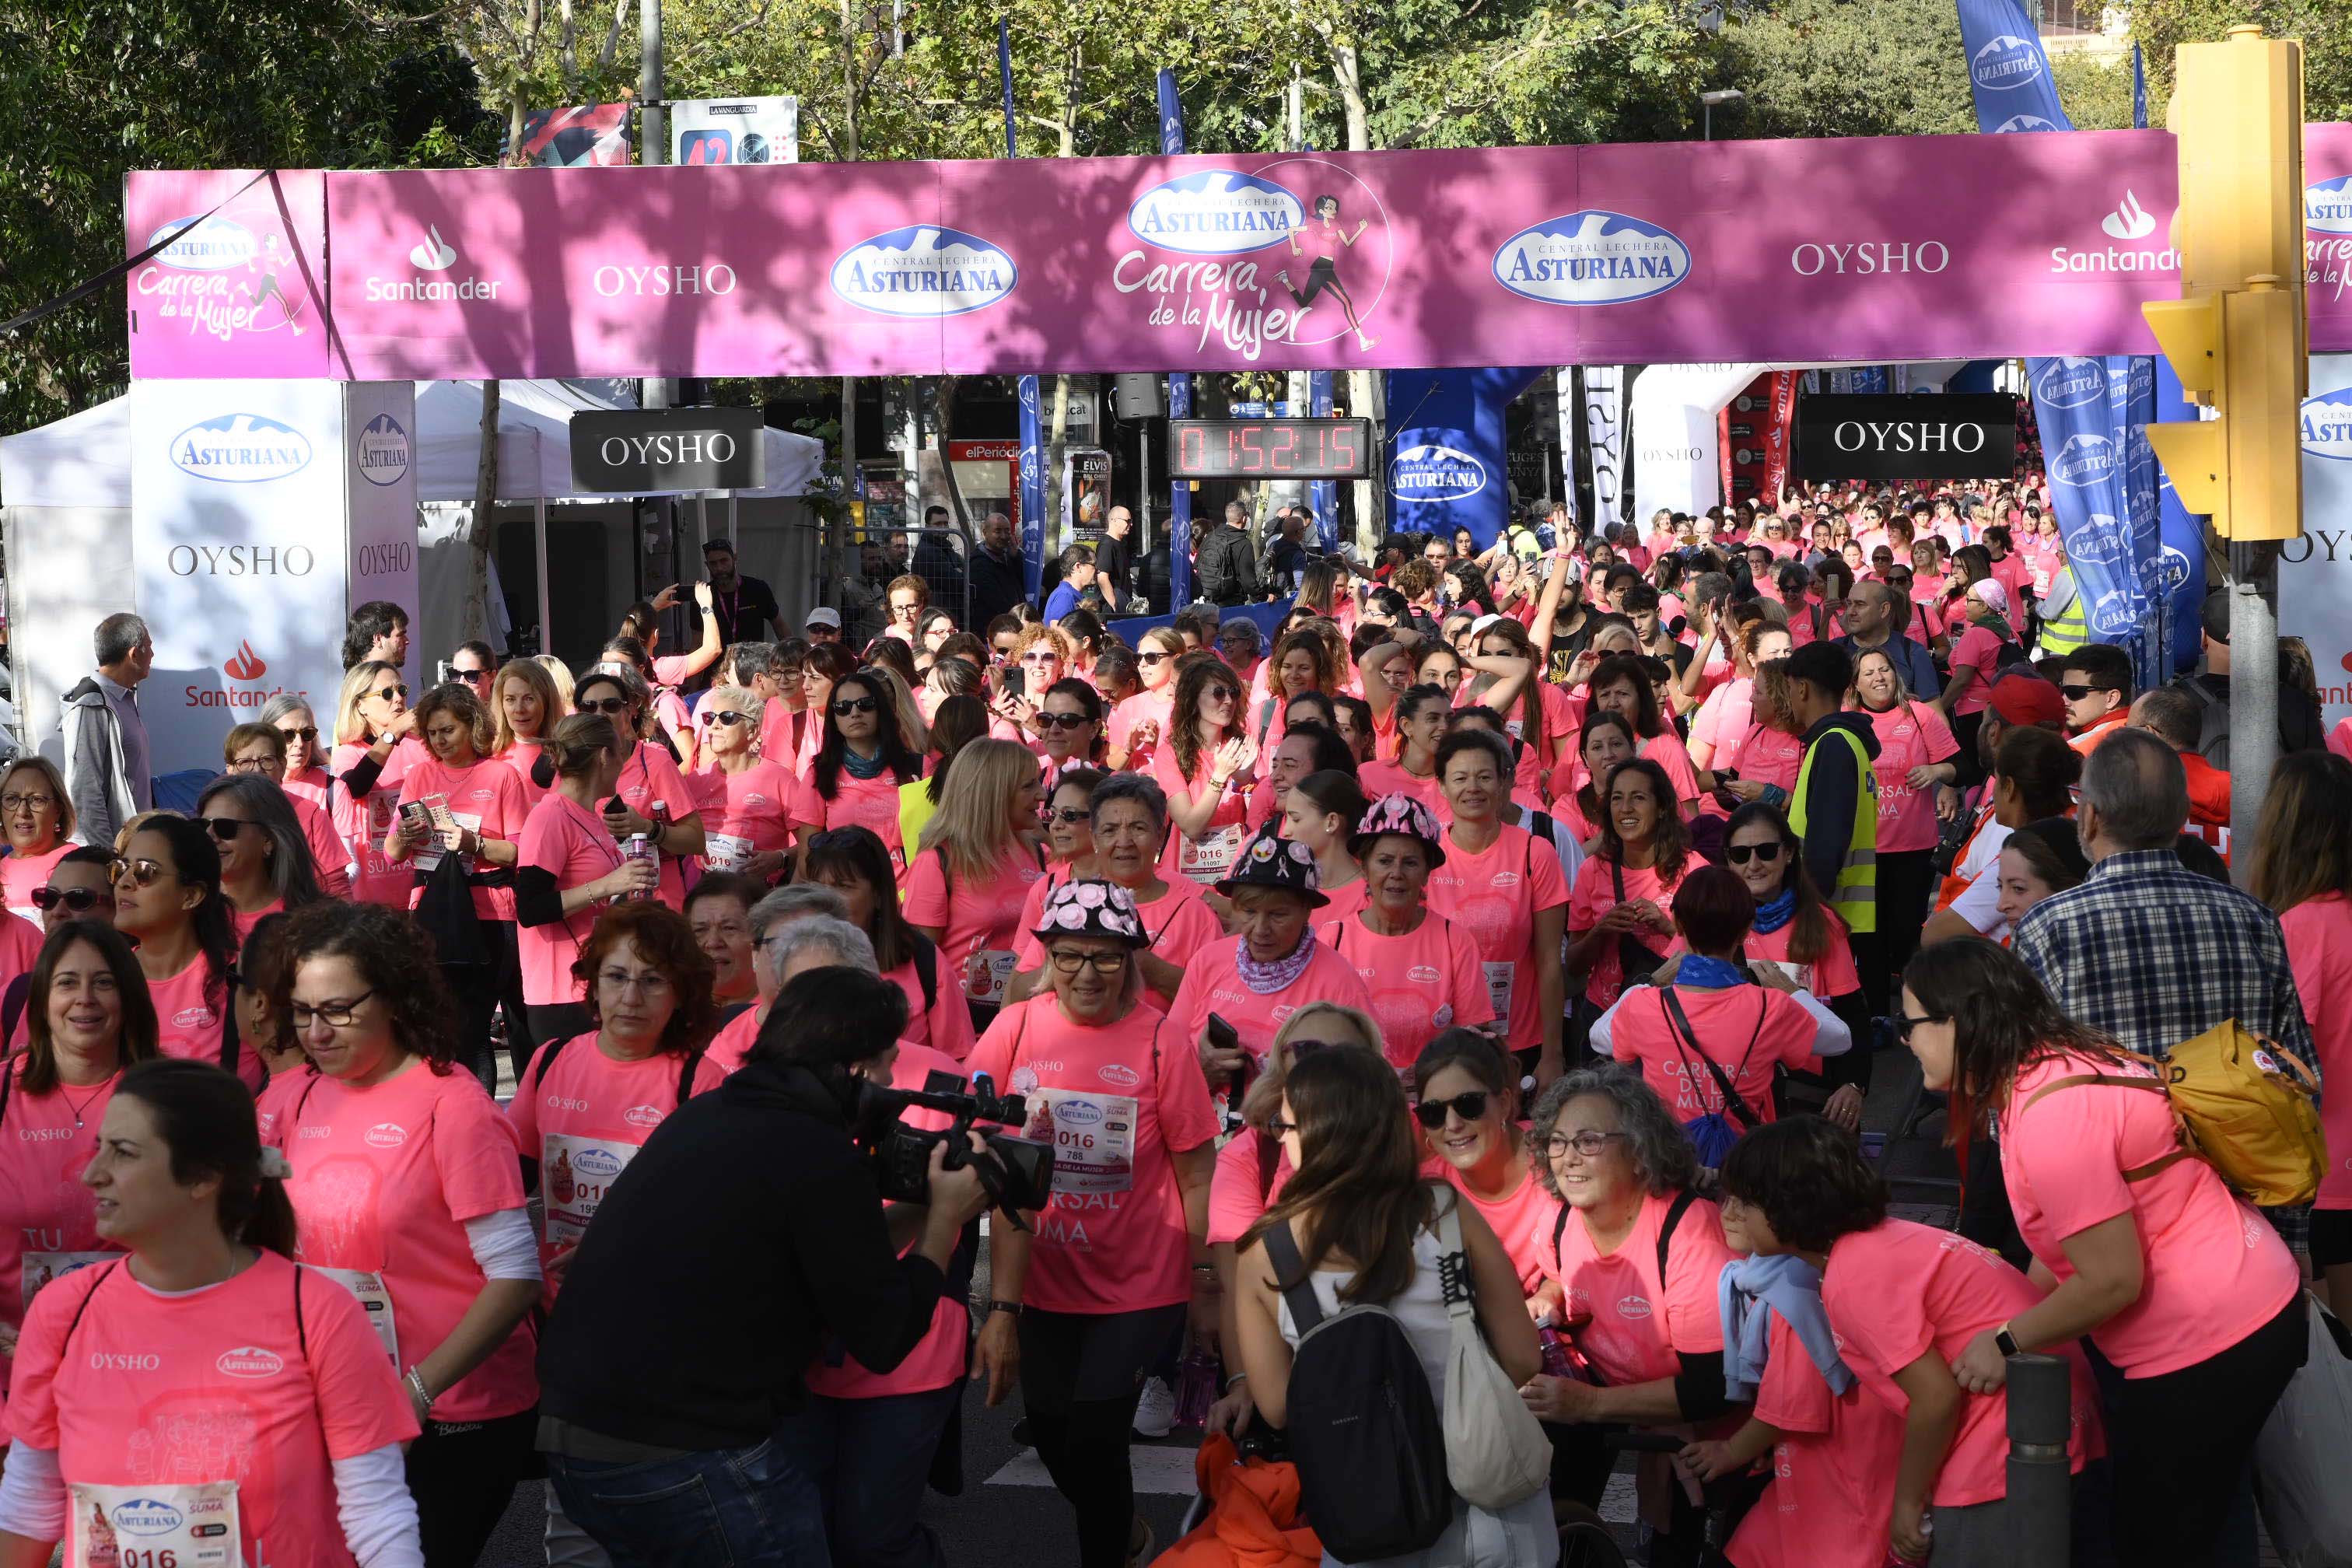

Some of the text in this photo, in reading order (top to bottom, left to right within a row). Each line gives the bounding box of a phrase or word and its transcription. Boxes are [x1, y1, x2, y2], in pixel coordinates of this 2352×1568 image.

[718, 105, 756, 114] VANGUARDIA
[1230, 198, 1286, 206] LECHERA
[1143, 201, 1290, 233] ASTURIANA
[1538, 241, 1669, 254] CENTRAL LECHERA
[1792, 240, 1949, 275] OYSHO
[873, 256, 996, 266] CENTRAL LECHERA
[1113, 250, 1258, 293] Carrera
[1508, 247, 1676, 282] ASTURIANA
[138, 266, 229, 296] Carrera
[593, 264, 737, 297] OYSHO
[846, 260, 1003, 293] ASTURIANA
[2324, 261, 2338, 284] la
[366, 275, 502, 302] Santander
[160, 292, 263, 341] de la Mujer
[1149, 287, 1312, 361] de la Mujer
[1834, 421, 1986, 453] OYSHO
[180, 439, 302, 466] ASTURIANA
[362, 443, 407, 469] ASTURIANA
[601, 432, 736, 467] OYSHO
[1643, 447, 1703, 461] OYSHO
[1083, 460, 1108, 471] ELVIS
[1391, 468, 1479, 489] ASTURIANA
[2279, 529, 2352, 564] OY
[167, 544, 314, 576] OYSHO
[359, 541, 410, 576] OYSHO
[185, 684, 307, 707] Santan
[710, 856, 731, 866] 016
[1200, 849, 1223, 859] 016
[1663, 1060, 1750, 1078] CARRRA
[1106, 1108, 1128, 1116] SUMA
[1676, 1094, 1725, 1110] MUJE
[1059, 1107, 1099, 1121] ASTURIANA
[19, 1128, 73, 1141] OYSHO
[1059, 1131, 1095, 1149] 016
[577, 1156, 618, 1172] ASTURIANA
[22, 1227, 62, 1251] TU
[90, 1353, 161, 1371] OYSHO
[222, 1357, 278, 1371] ASTURIANA
[188, 1503, 225, 1514] SUMA
[117, 1512, 177, 1528] ASTURIANA
[124, 1548, 177, 1568] 016
